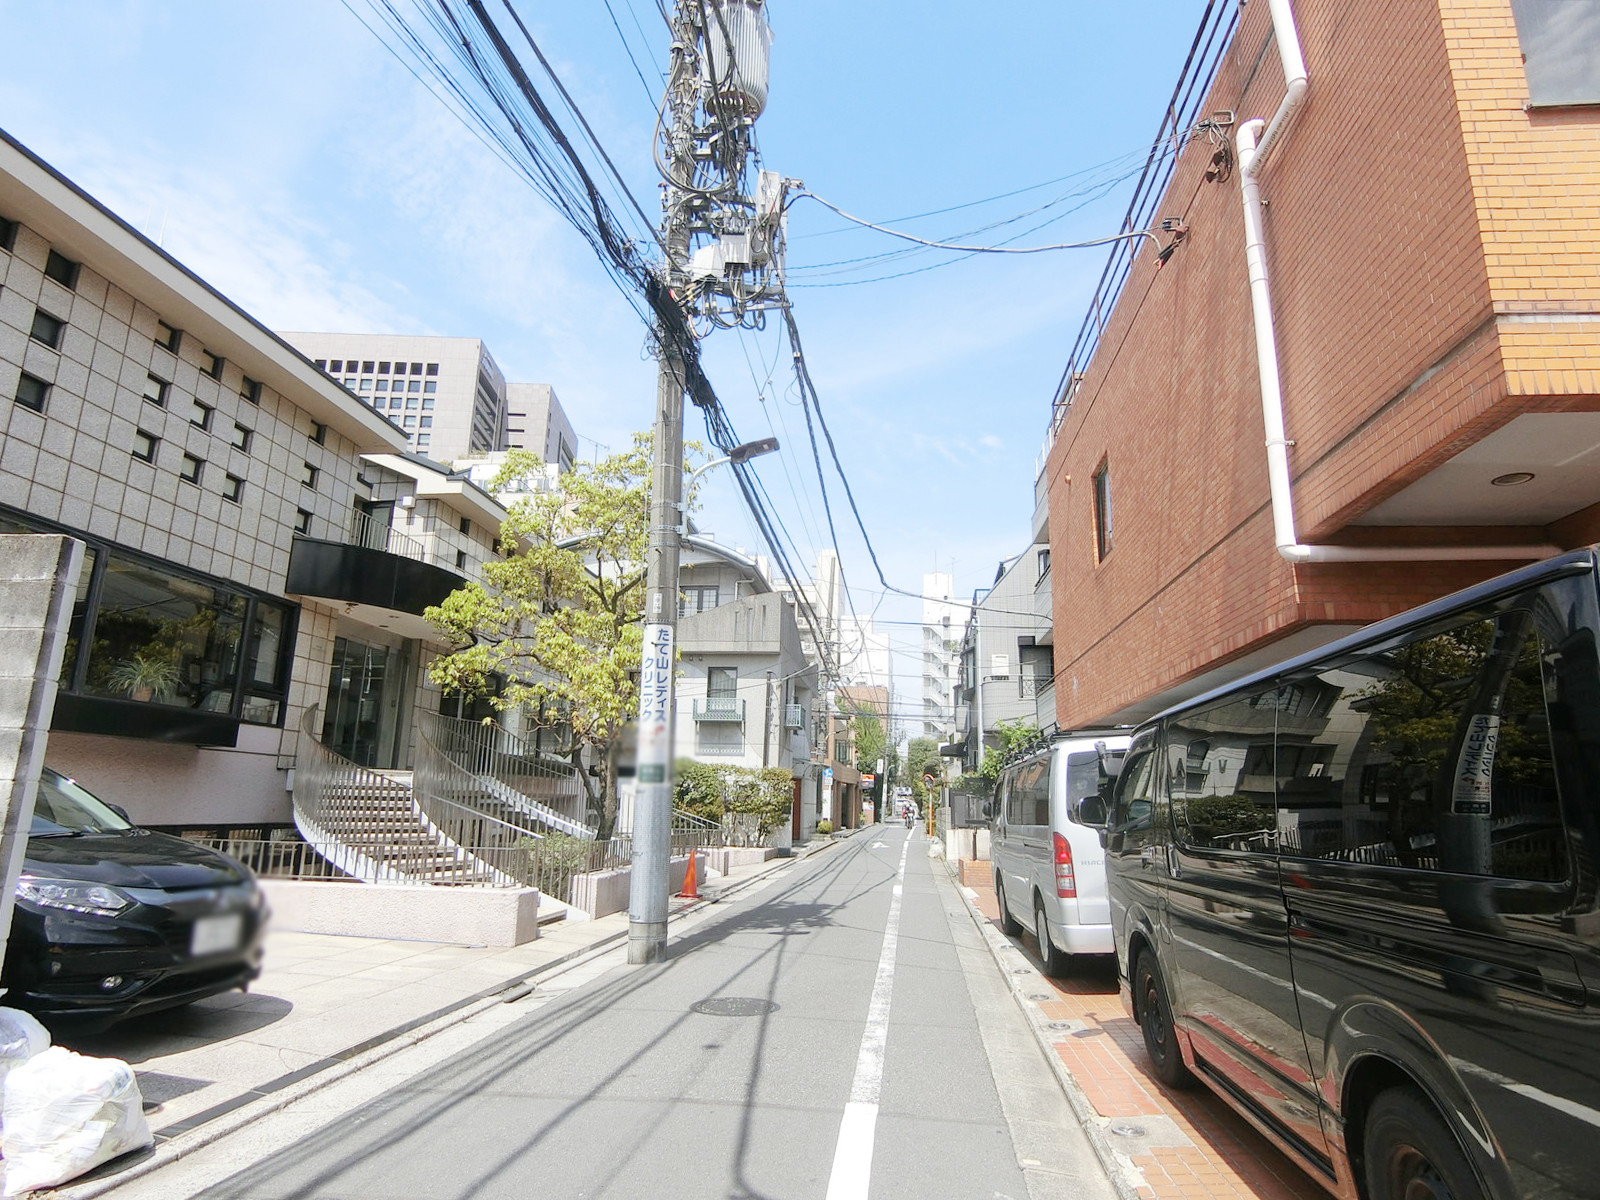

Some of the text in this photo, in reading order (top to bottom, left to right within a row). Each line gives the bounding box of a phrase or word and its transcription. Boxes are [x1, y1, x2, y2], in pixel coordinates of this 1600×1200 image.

[641, 657, 654, 722] クリニック
[654, 628, 671, 722] たて山レディス
